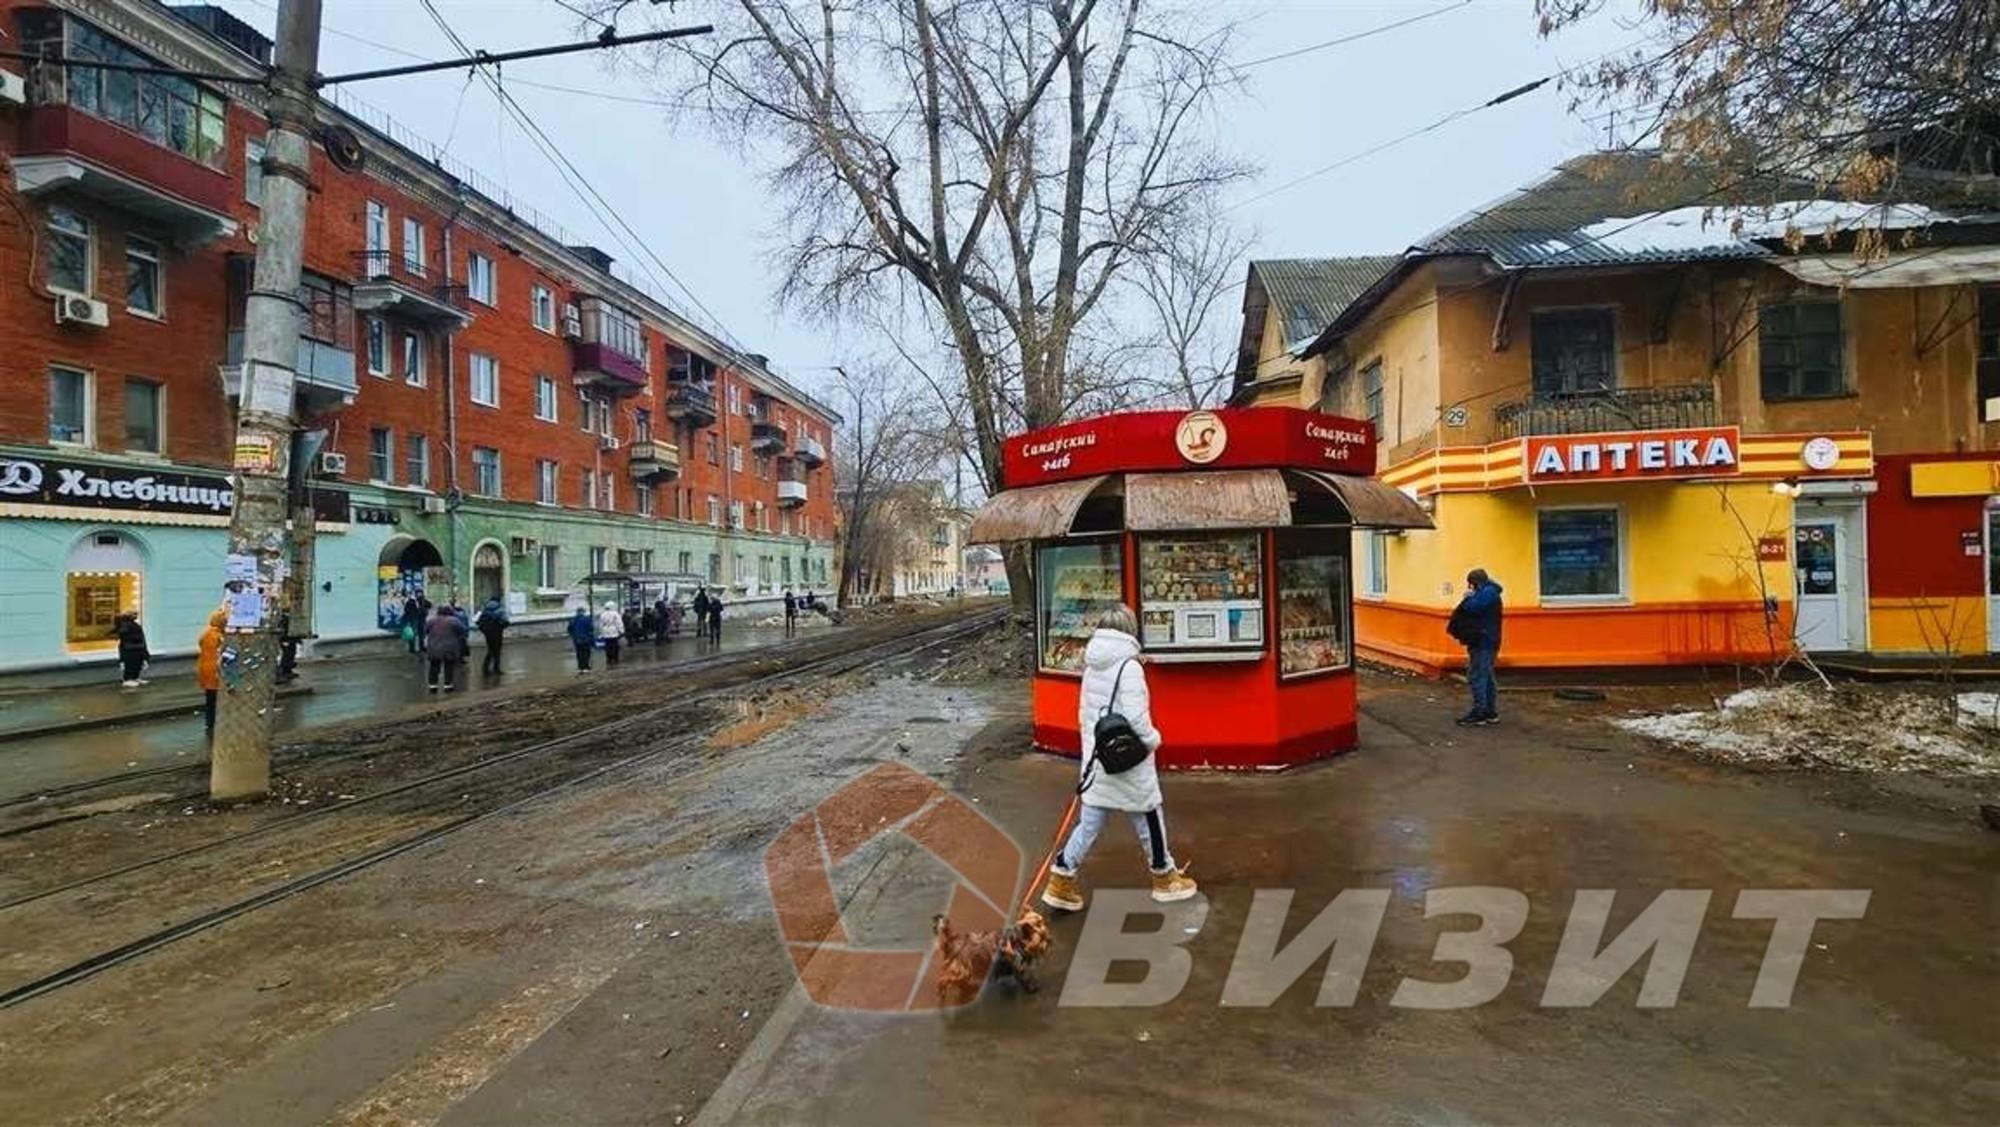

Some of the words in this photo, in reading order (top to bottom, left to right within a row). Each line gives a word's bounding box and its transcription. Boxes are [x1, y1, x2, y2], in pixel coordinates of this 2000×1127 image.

[1448, 410, 1465, 423] 29
[1022, 430, 1096, 458] Самарский
[1532, 437, 1736, 475] АПТЕКА
